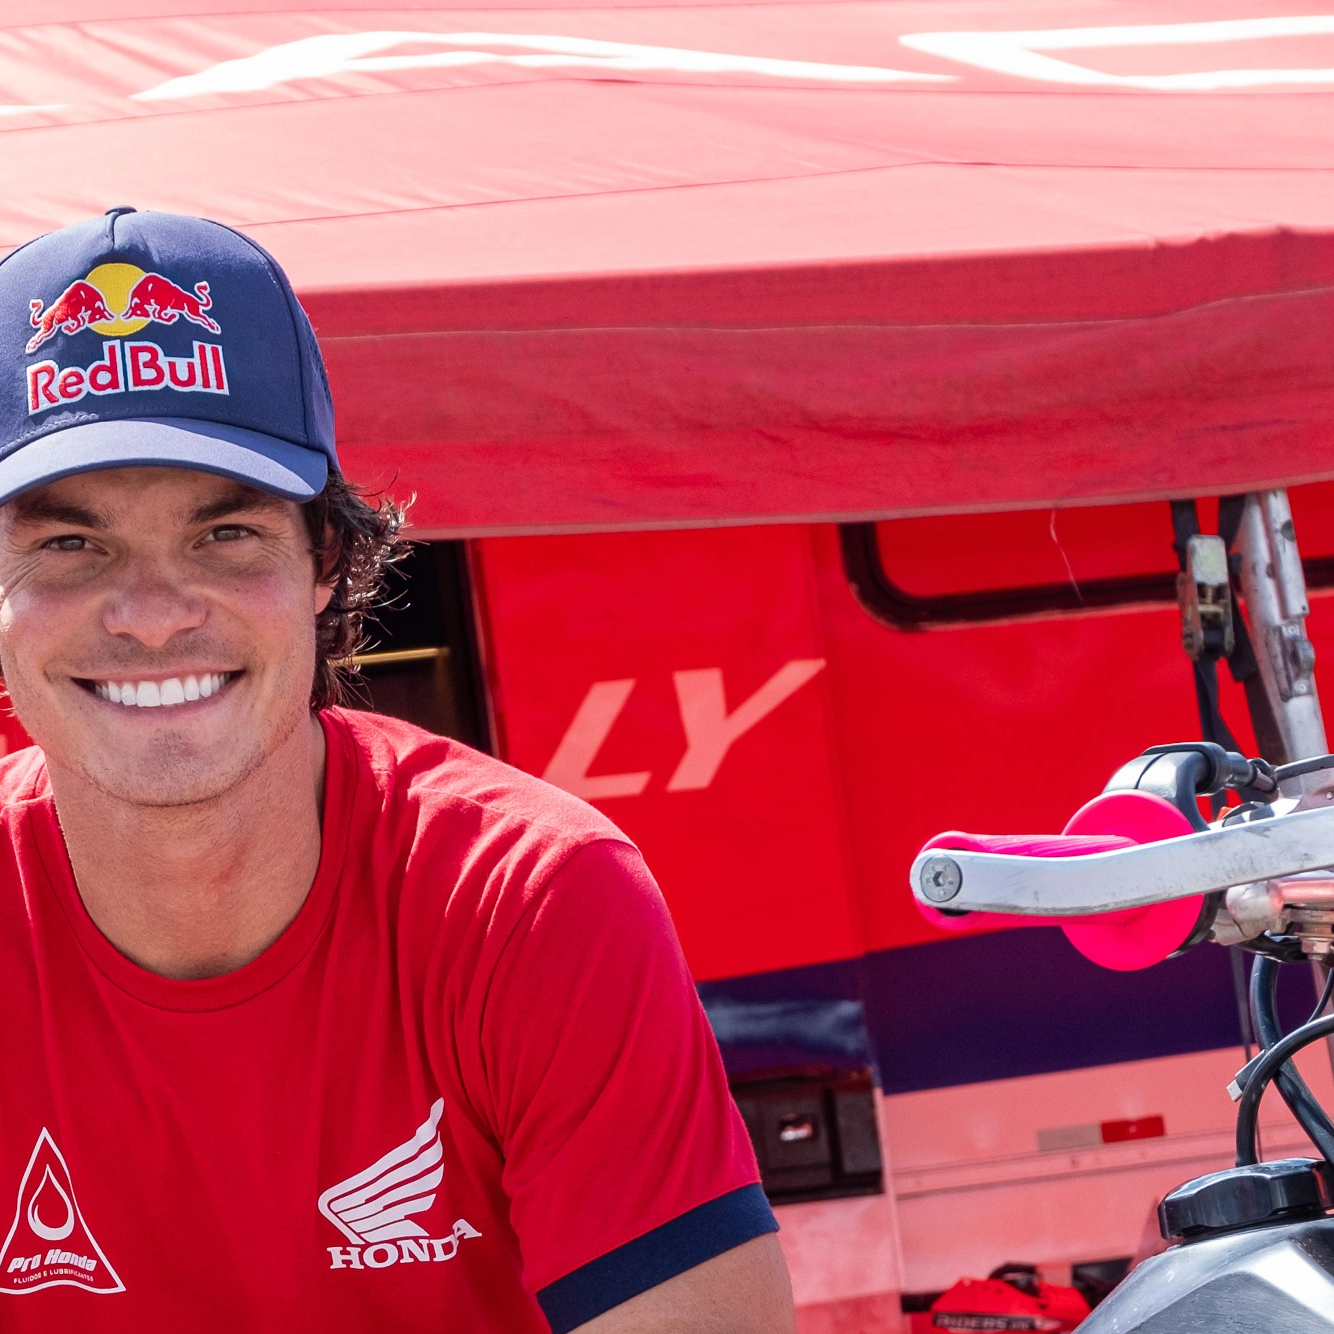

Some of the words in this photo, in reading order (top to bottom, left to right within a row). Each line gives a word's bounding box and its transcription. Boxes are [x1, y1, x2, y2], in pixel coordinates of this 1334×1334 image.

[27, 342, 123, 414] Red
[126, 342, 229, 394] Bull
[7, 1254, 42, 1273] Pro
[44, 1248, 98, 1272] Honda
[327, 1218, 482, 1270] HONDA
